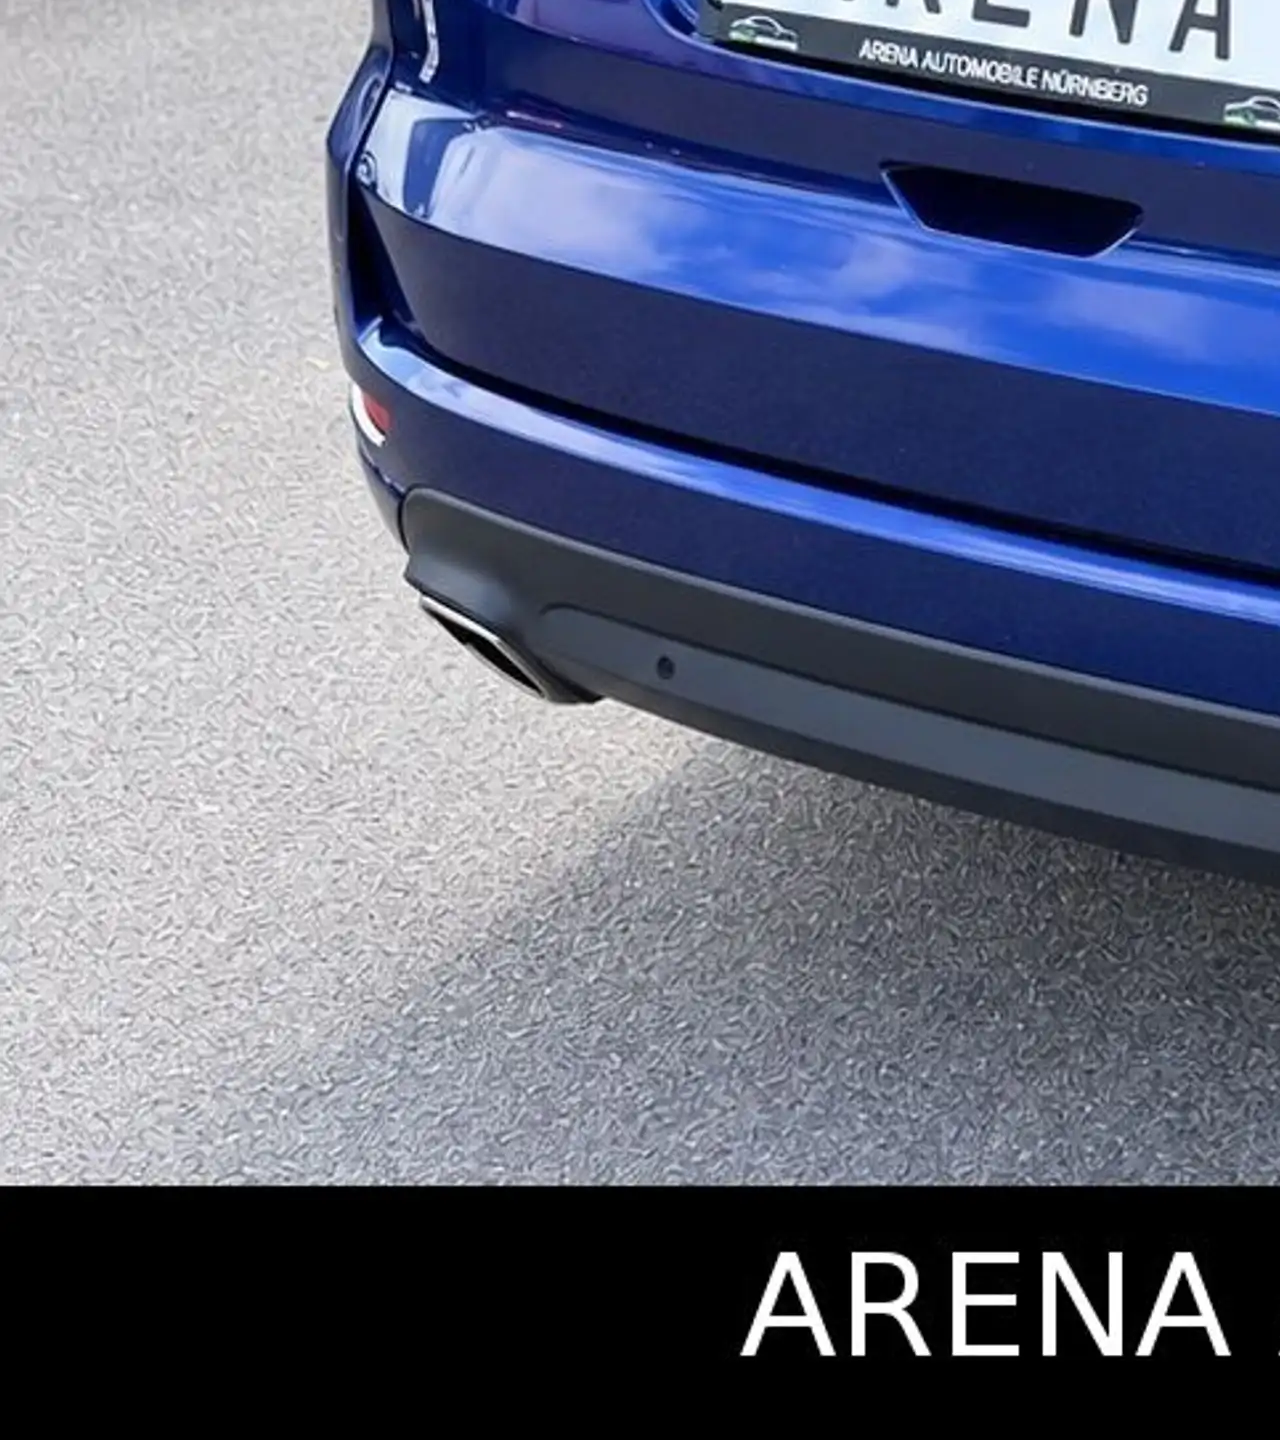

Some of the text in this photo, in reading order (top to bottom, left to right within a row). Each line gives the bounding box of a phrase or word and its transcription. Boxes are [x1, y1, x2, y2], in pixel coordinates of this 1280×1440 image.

[859, 38, 1149, 106] ARENA AUTOMOBILE NÜRNBERG
